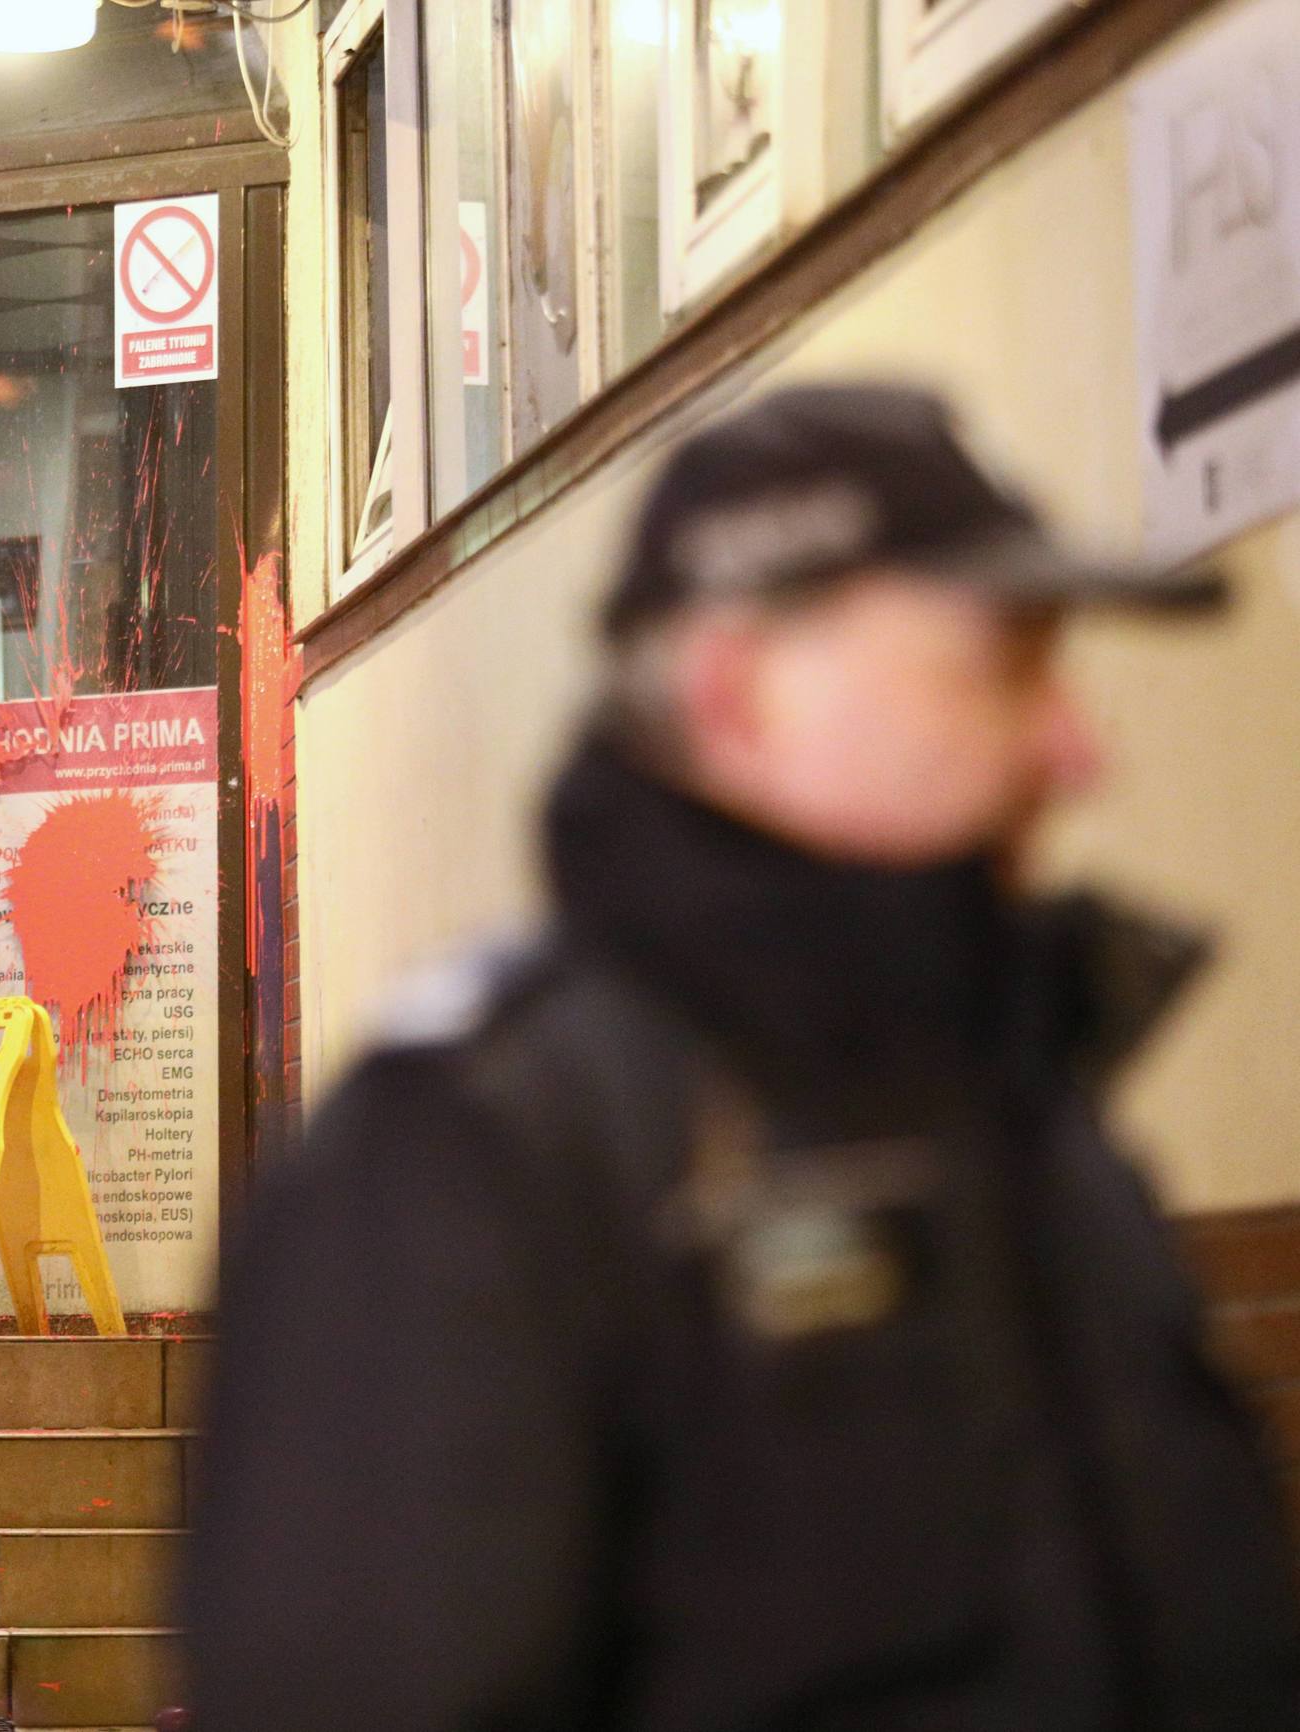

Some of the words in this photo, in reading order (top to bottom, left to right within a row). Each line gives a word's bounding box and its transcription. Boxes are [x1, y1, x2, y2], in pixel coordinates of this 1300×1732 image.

[129, 337, 167, 353] PALENIE
[168, 333, 206, 350] TYTONIU
[138, 351, 197, 369] ZABRONIONE
[113, 716, 205, 752] PRIMA
[136, 941, 194, 955] ekarskie
[157, 987, 194, 1002] pracy
[163, 1005, 194, 1019] USG
[152, 1026, 194, 1042] piersi)
[114, 1048, 153, 1061] ECHO
[157, 1049, 194, 1060] serca
[162, 1067, 193, 1080] EMG
[98, 1087, 193, 1104] Densytometria
[96, 1107, 193, 1124] Kapilaroskopia
[145, 1128, 193, 1143] Holtery
[128, 1149, 193, 1162] PH-metria
[154, 1168, 193, 1184] Pylori
[103, 1189, 193, 1204] endoskopowe
[161, 1207, 193, 1222] EUS)
[105, 1230, 193, 1244] endoskopowa
